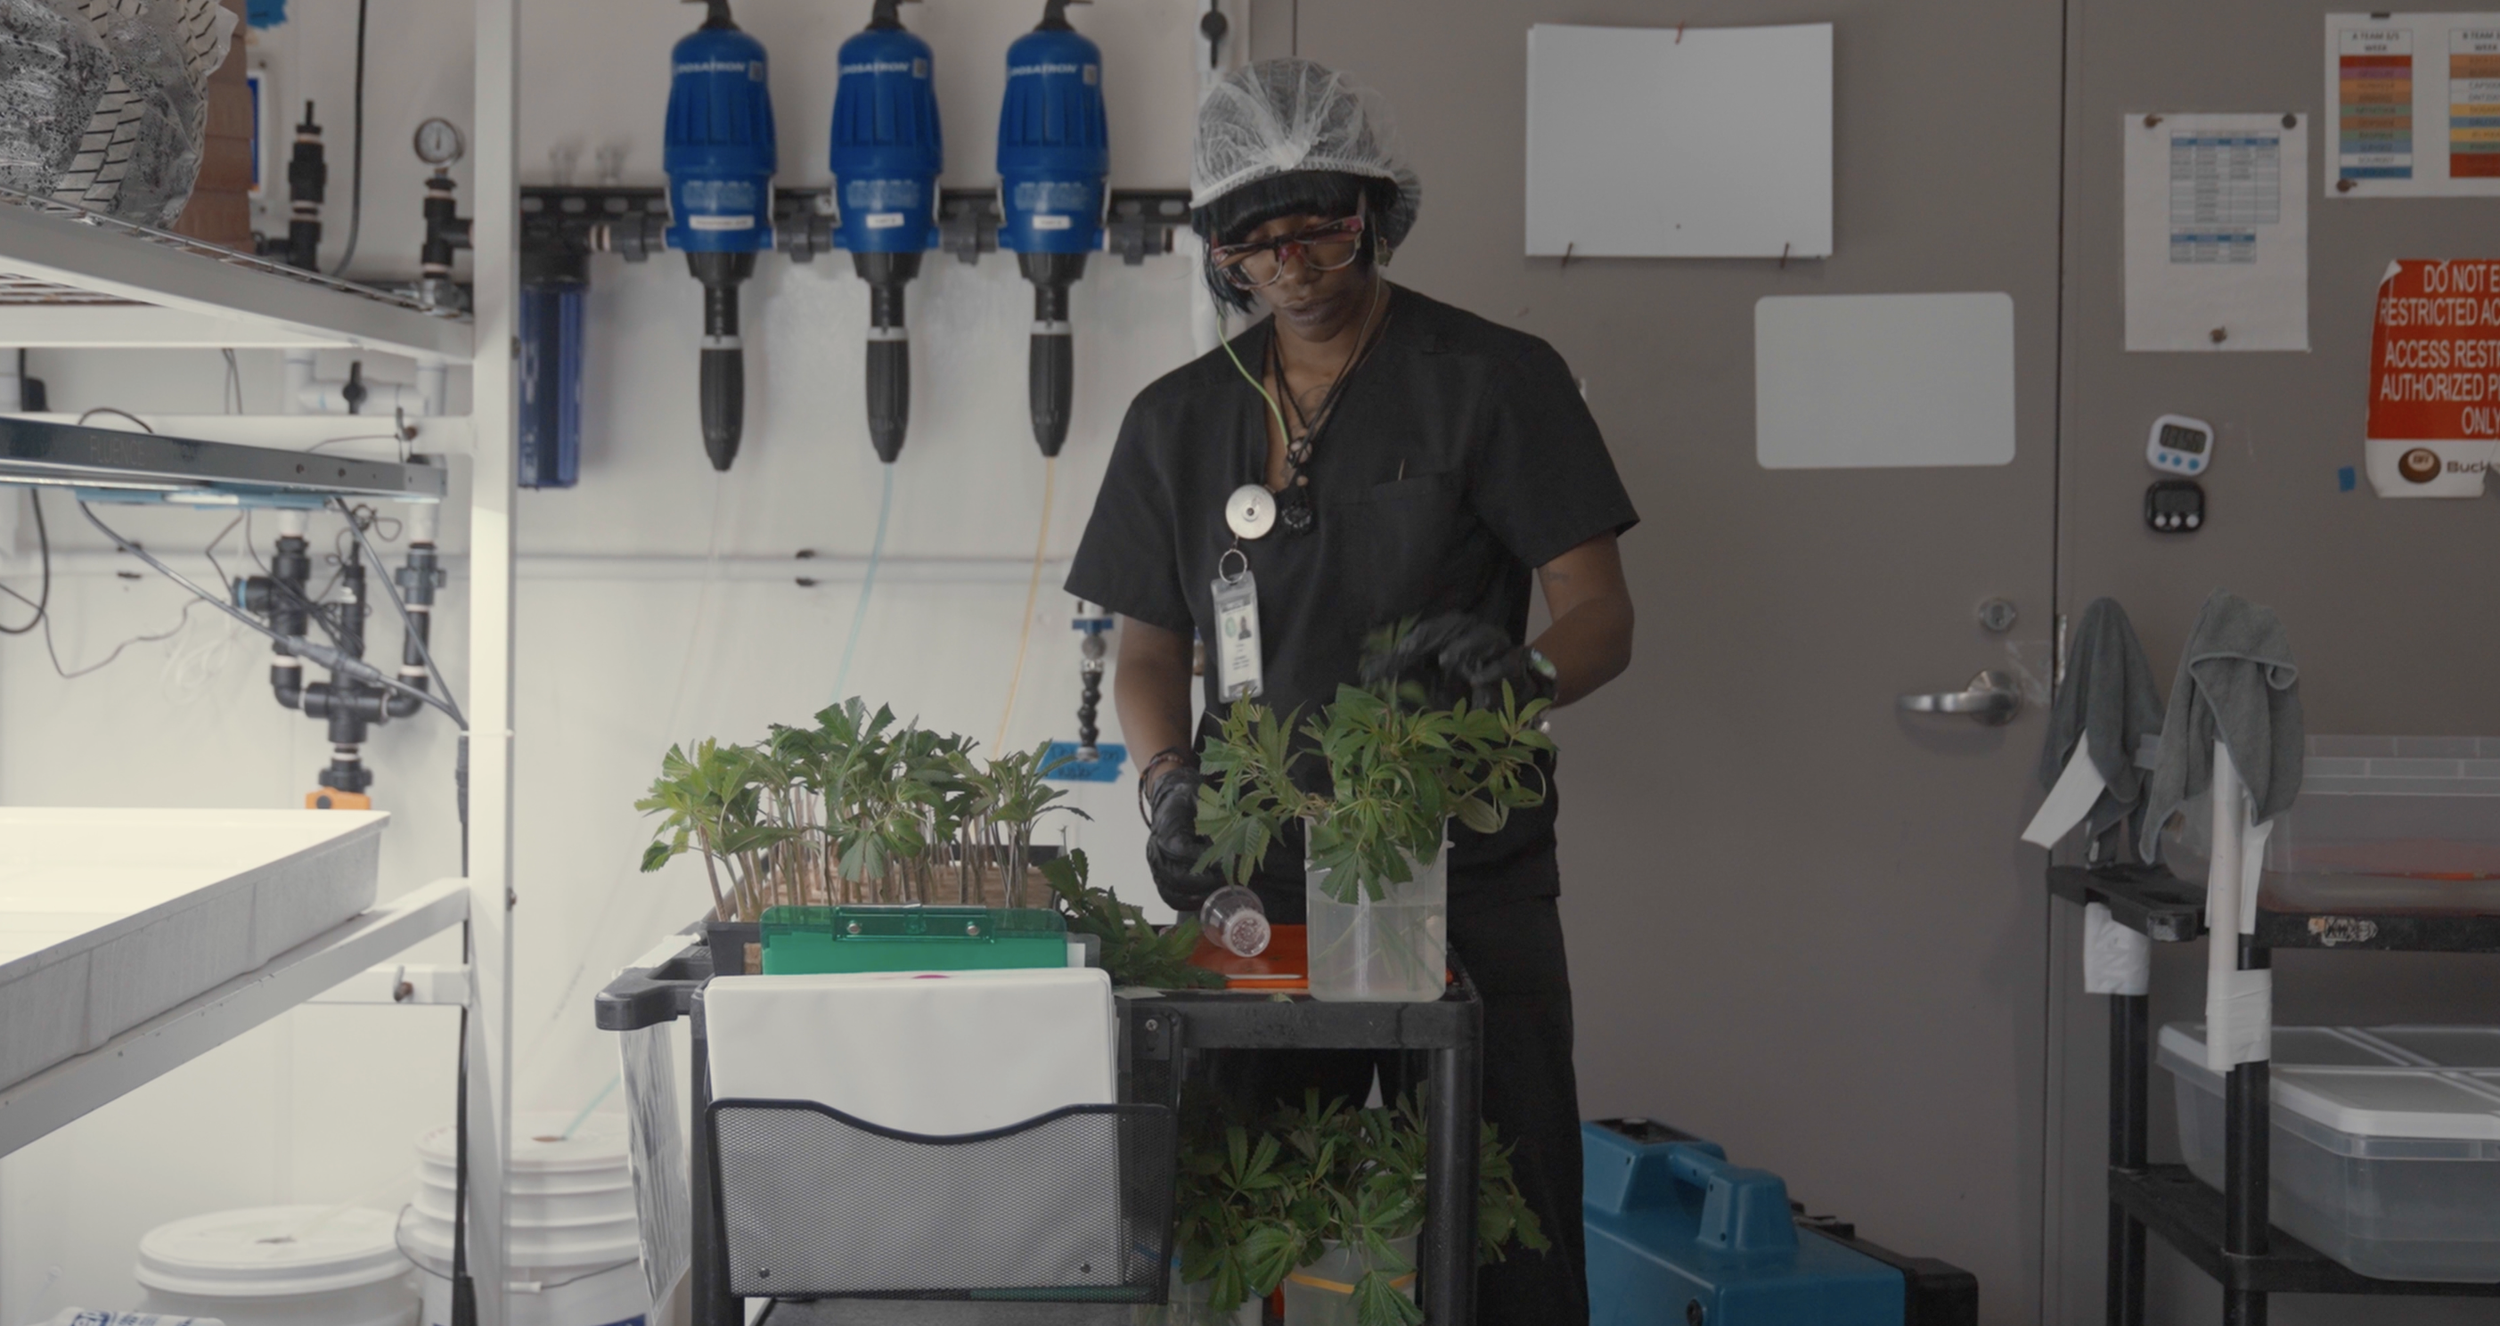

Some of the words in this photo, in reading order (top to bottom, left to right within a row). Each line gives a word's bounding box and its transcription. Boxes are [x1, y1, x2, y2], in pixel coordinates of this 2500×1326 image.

[2423, 264, 2449, 294] DO
[2452, 264, 2487, 294] NOT
[2379, 298, 2478, 327] RESTRICTED
[2384, 339, 2451, 370] ACCESS
[2380, 373, 2485, 402] AUTHORIZED
[89, 435, 146, 466] FLUENCE
